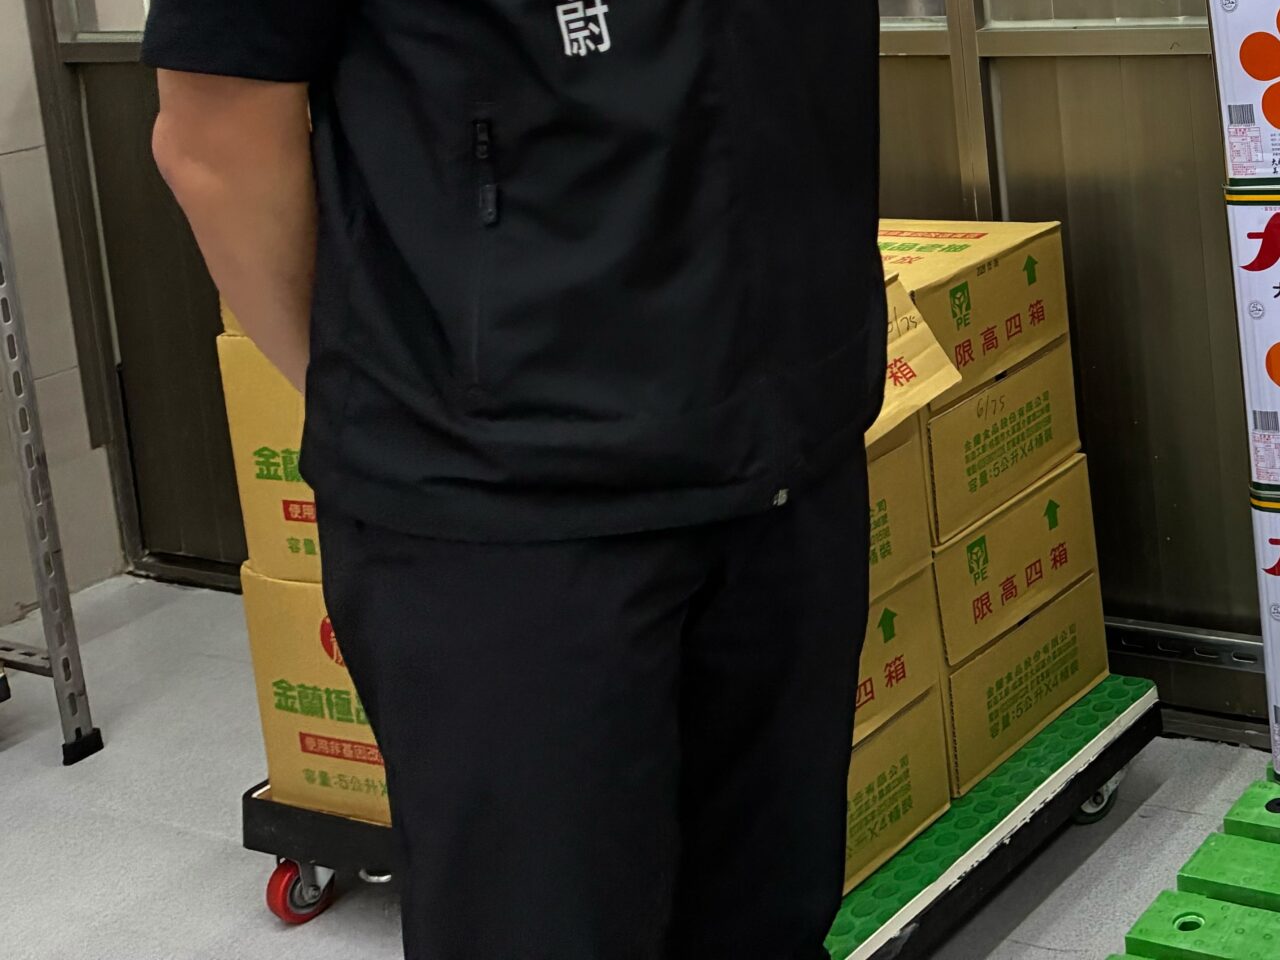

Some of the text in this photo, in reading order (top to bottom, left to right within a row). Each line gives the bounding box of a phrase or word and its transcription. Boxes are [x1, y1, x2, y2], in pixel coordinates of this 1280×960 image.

[954, 299, 1046, 369] 限高四箱
[956, 314, 971, 331] PE
[887, 356, 917, 387] 箱
[972, 541, 1069, 625] 限高四箱
[973, 567, 989, 586] PE
[856, 654, 907, 713] 四箱
